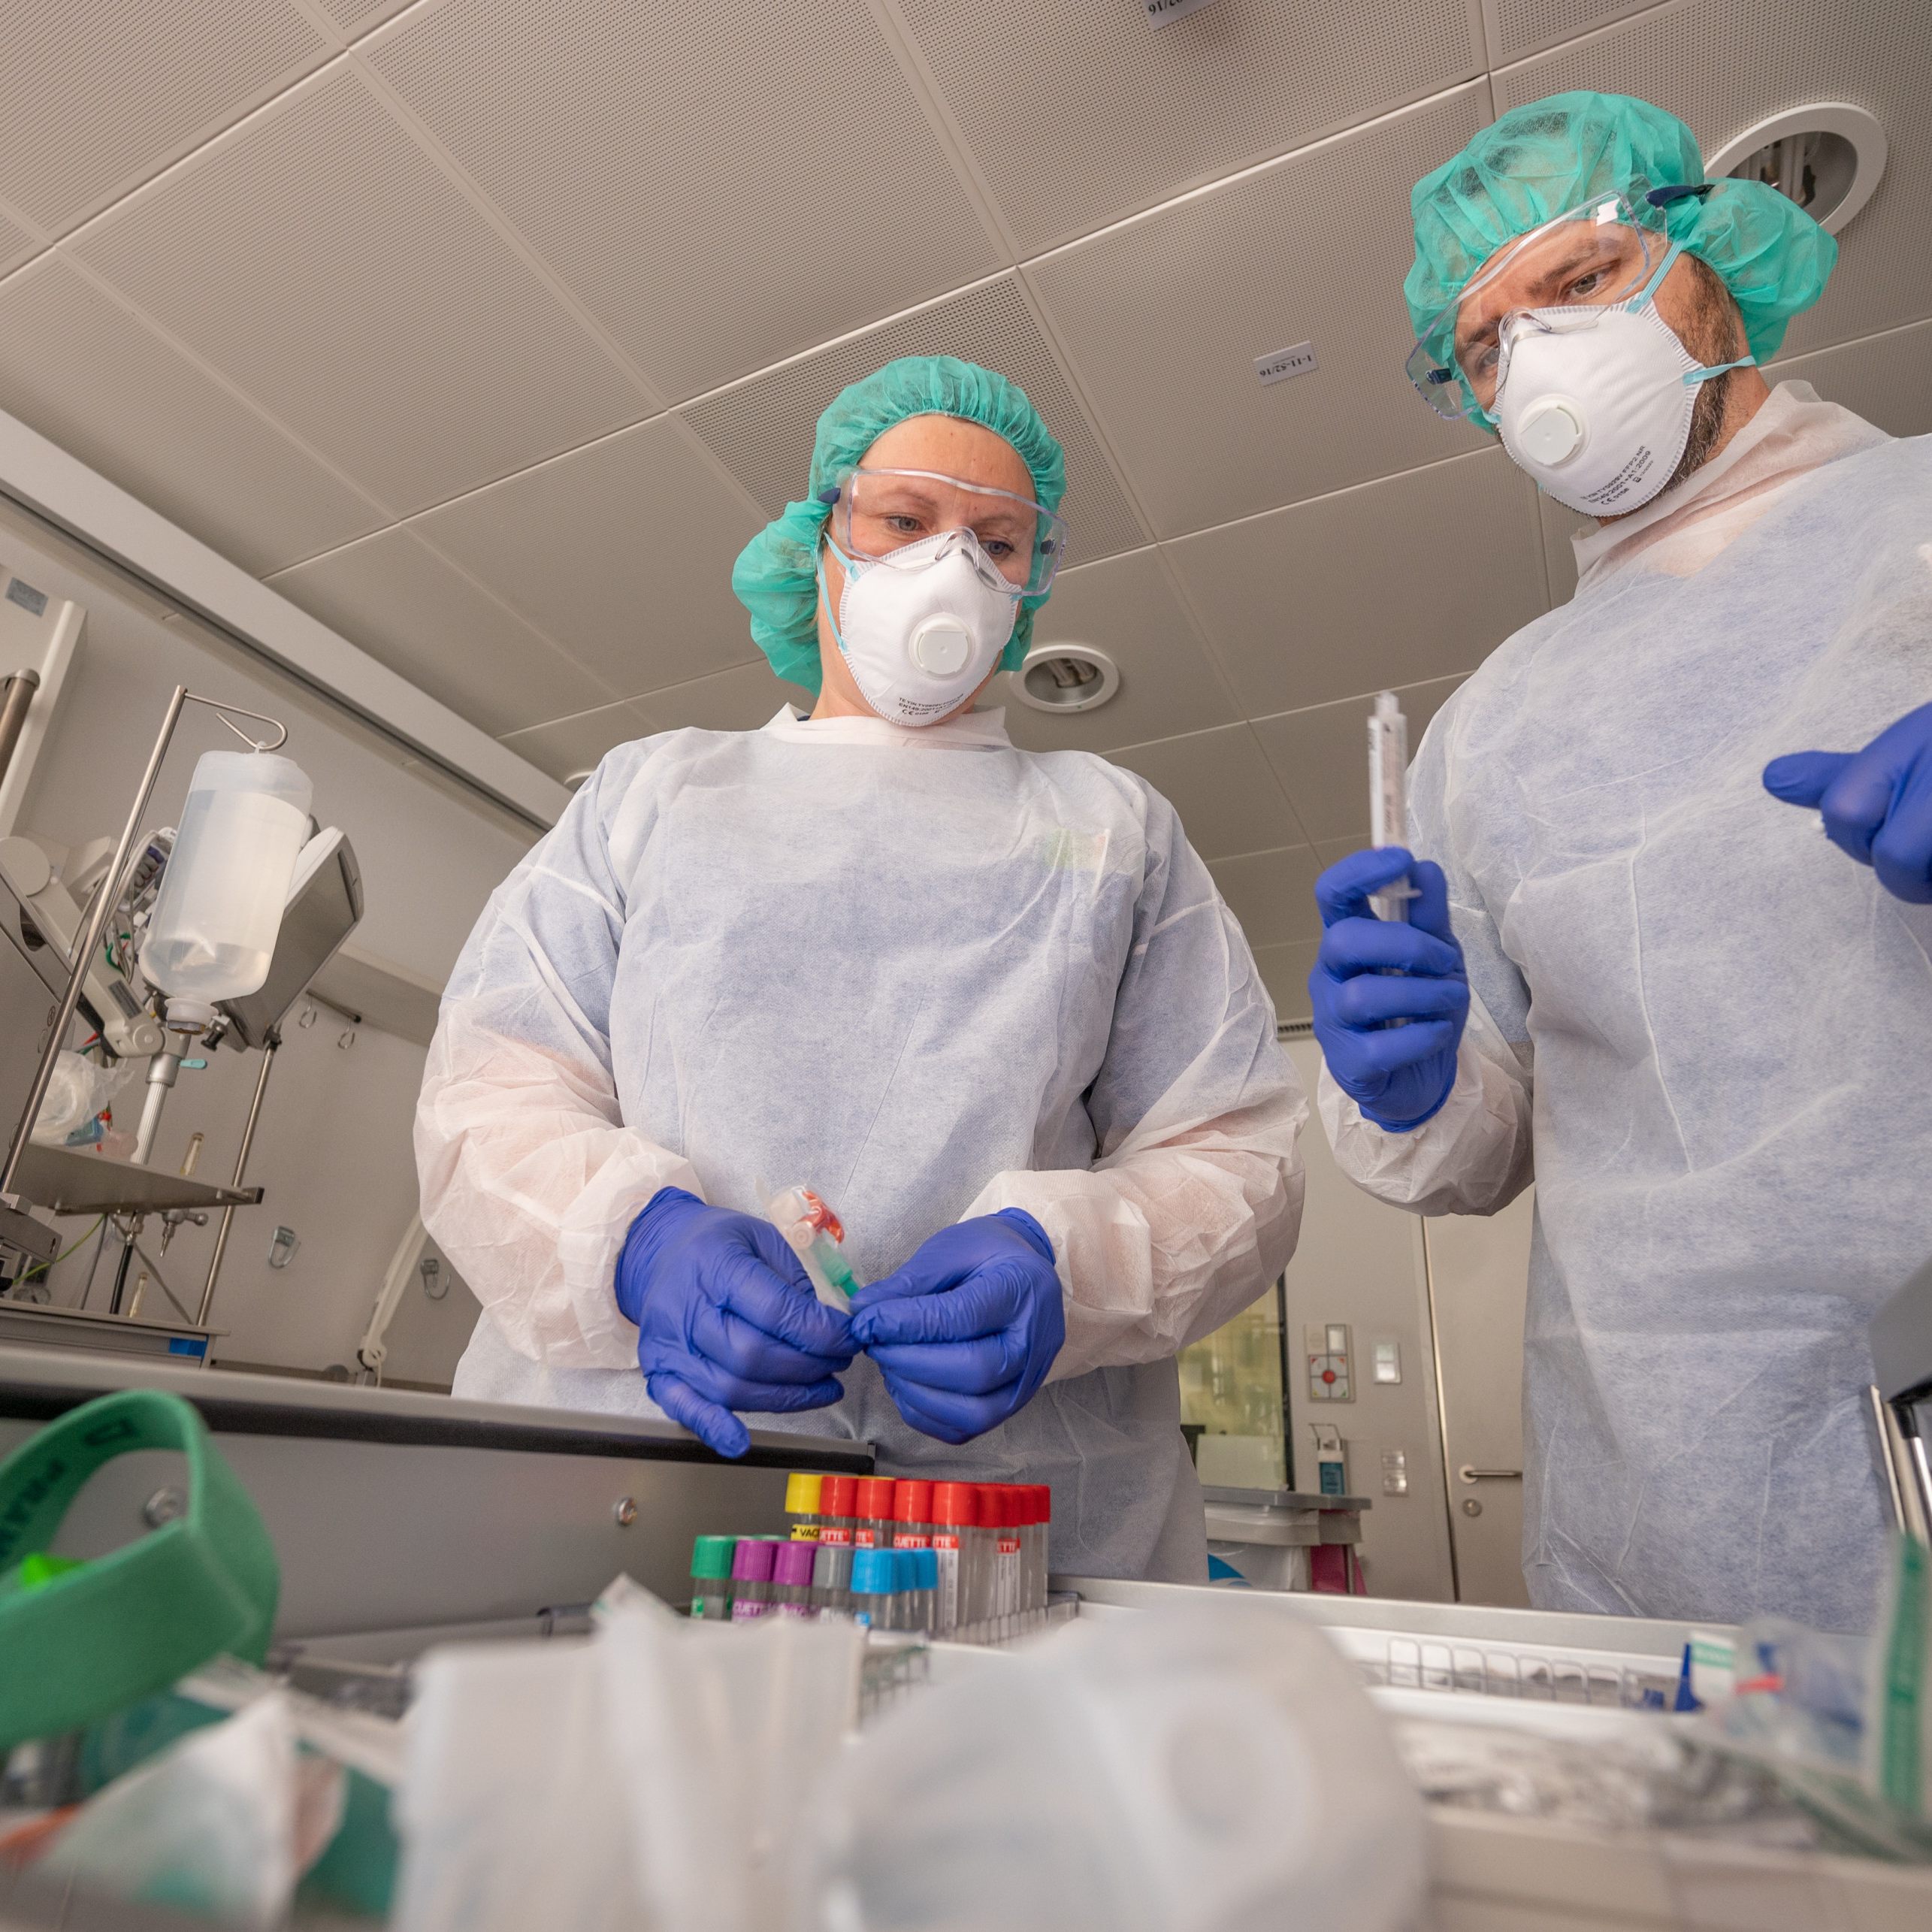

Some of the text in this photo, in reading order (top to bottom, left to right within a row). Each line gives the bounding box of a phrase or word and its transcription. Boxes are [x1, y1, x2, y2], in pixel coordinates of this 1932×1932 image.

[1259, 355, 1312, 376] 1-11-52/16
[1622, 457, 1637, 473] FFP2
[1636, 445, 1646, 456] NR
